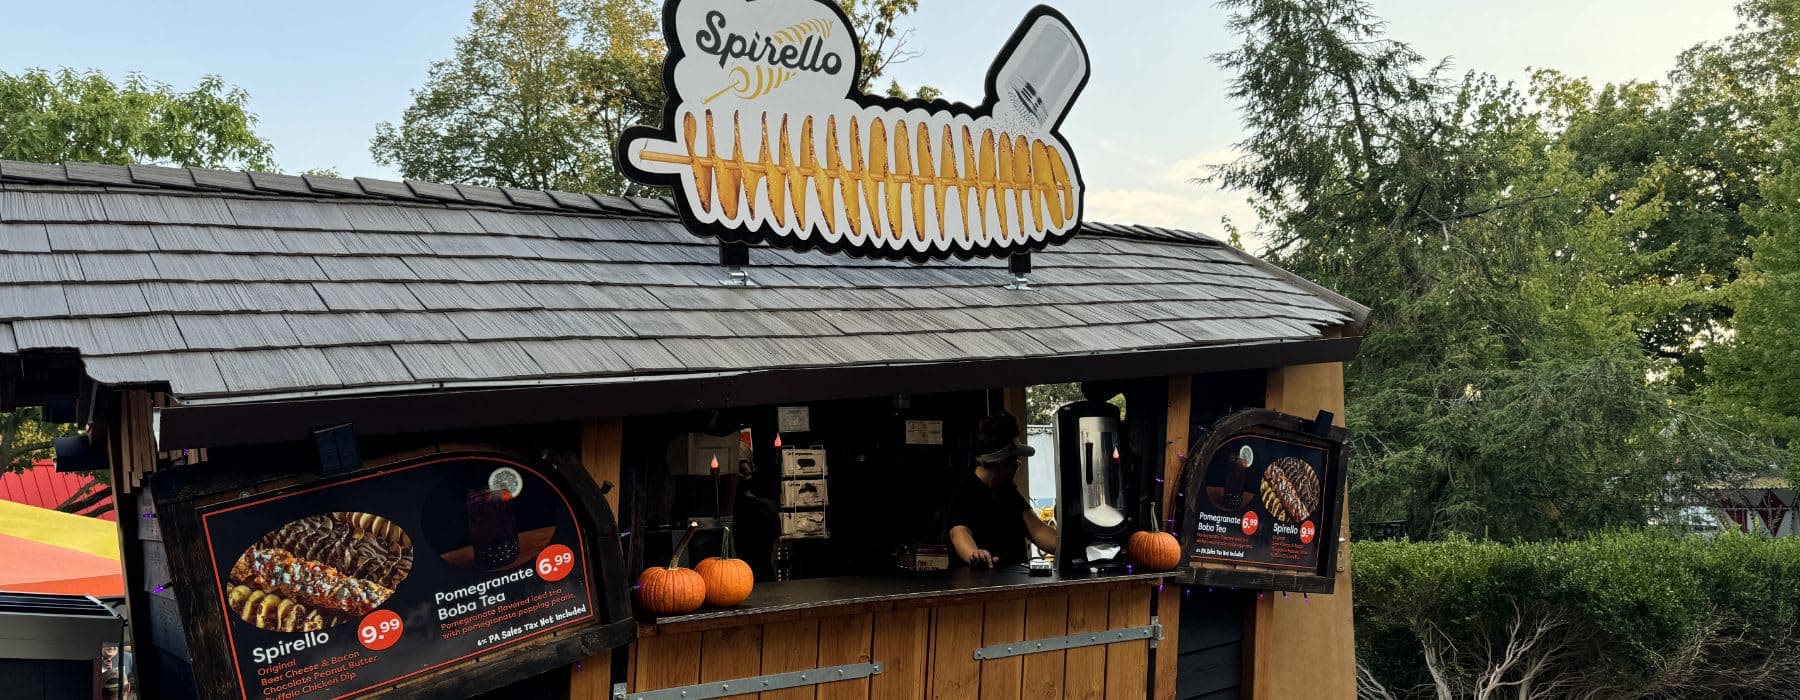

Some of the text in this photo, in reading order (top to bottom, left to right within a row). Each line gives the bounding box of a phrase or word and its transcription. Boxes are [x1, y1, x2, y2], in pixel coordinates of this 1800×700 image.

[696, 10, 842, 75] Spirello
[1198, 522, 1227, 533] Boba Tea
[1200, 511, 1241, 525] Pomegranate
[1242, 517, 1259, 529] 6.99
[1273, 522, 1299, 535] Spirello
[1300, 526, 1315, 538] 9.99
[538, 552, 572, 575] 6.99
[435, 568, 534, 605] Pomegranate
[438, 592, 506, 621] Boba Tea
[440, 609, 496, 631] Pomegranate
[497, 599, 530, 615] flavored
[549, 588, 562, 597] tea
[361, 618, 400, 644] 9.99
[441, 629, 461, 640] with
[462, 612, 517, 634] pomegranate
[518, 601, 550, 616] popping
[488, 634, 501, 644] PA
[501, 627, 523, 639] Sales
[523, 622, 539, 632] Tax
[540, 616, 554, 627] Not
[555, 604, 587, 620] Included
[252, 632, 330, 664] Spirello
[257, 659, 297, 676] Original
[261, 651, 360, 687] Beer Cheese & Bacon
[263, 655, 378, 696] Chocolate Peanut Butter
[302, 677, 339, 694] Chicken
[340, 671, 357, 683] Dip
